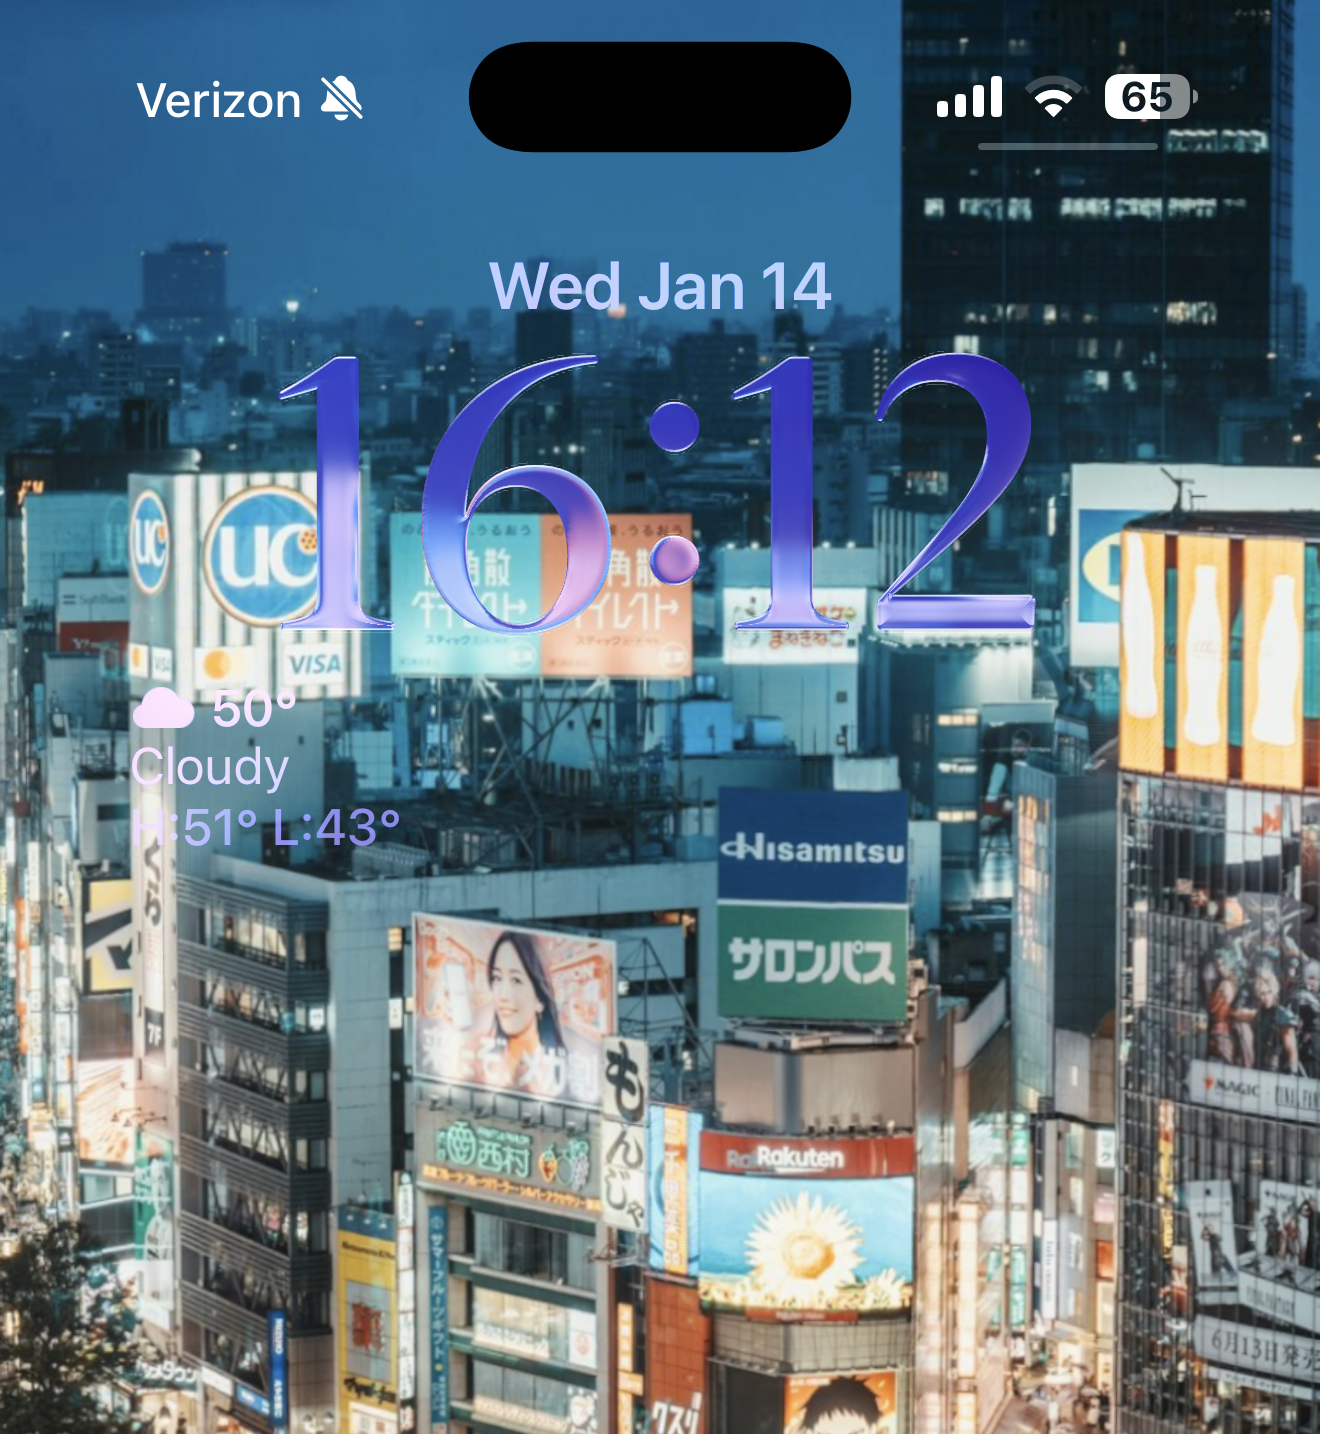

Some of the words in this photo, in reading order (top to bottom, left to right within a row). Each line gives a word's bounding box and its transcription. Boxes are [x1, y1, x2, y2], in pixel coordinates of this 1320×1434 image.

[289, 653, 342, 675] VISA
[720, 831, 905, 866] Hisamitsu
[729, 936, 896, 986] サロンパス
[604, 1039, 646, 1229] もんじゃ
[477, 1139, 531, 1178] 西村
[757, 1145, 845, 1169] Rakuten
